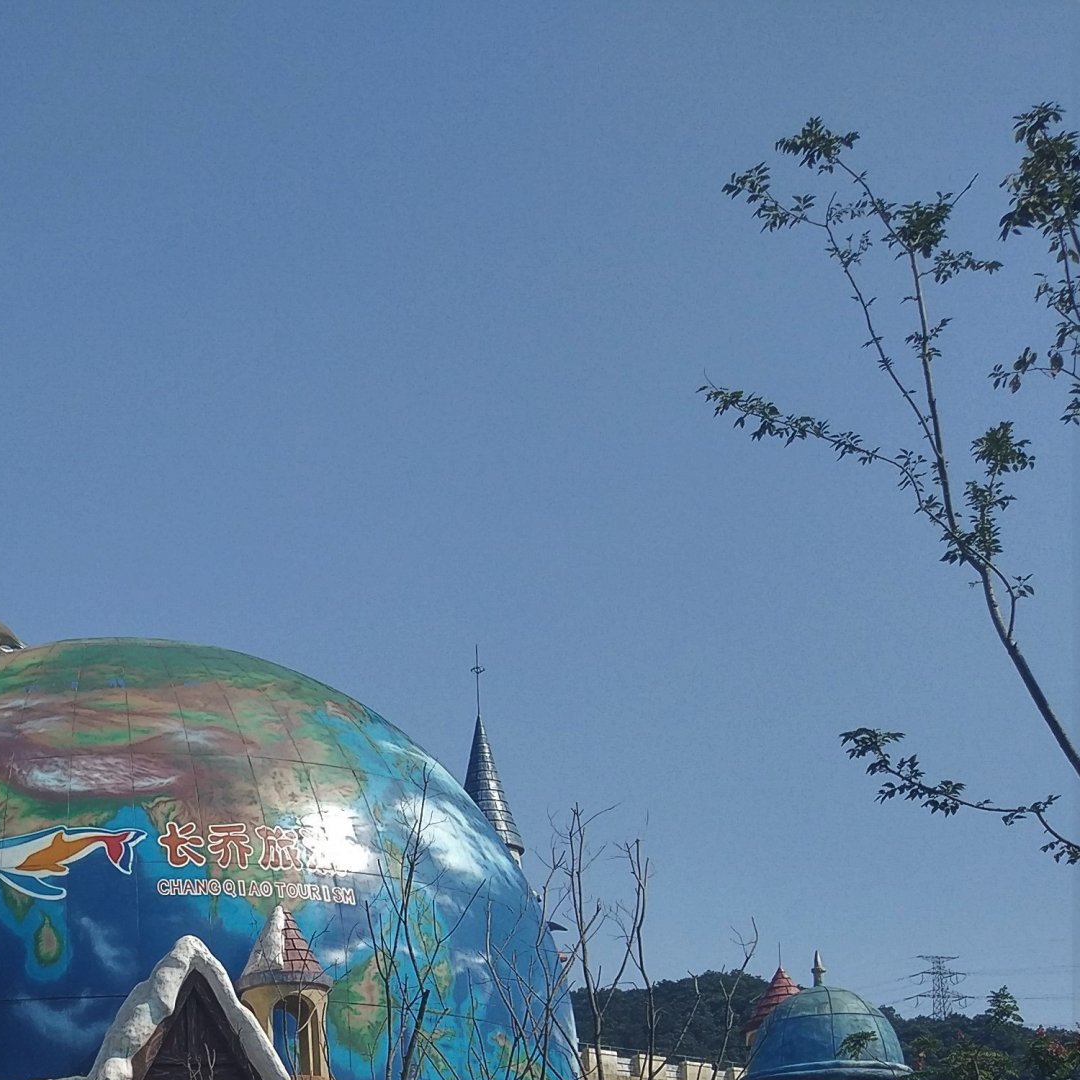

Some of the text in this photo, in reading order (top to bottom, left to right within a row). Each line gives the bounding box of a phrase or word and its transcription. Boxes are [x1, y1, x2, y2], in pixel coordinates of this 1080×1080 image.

[157, 822, 349, 878] 长乔旅
[275, 882, 357, 905] TOURISM
